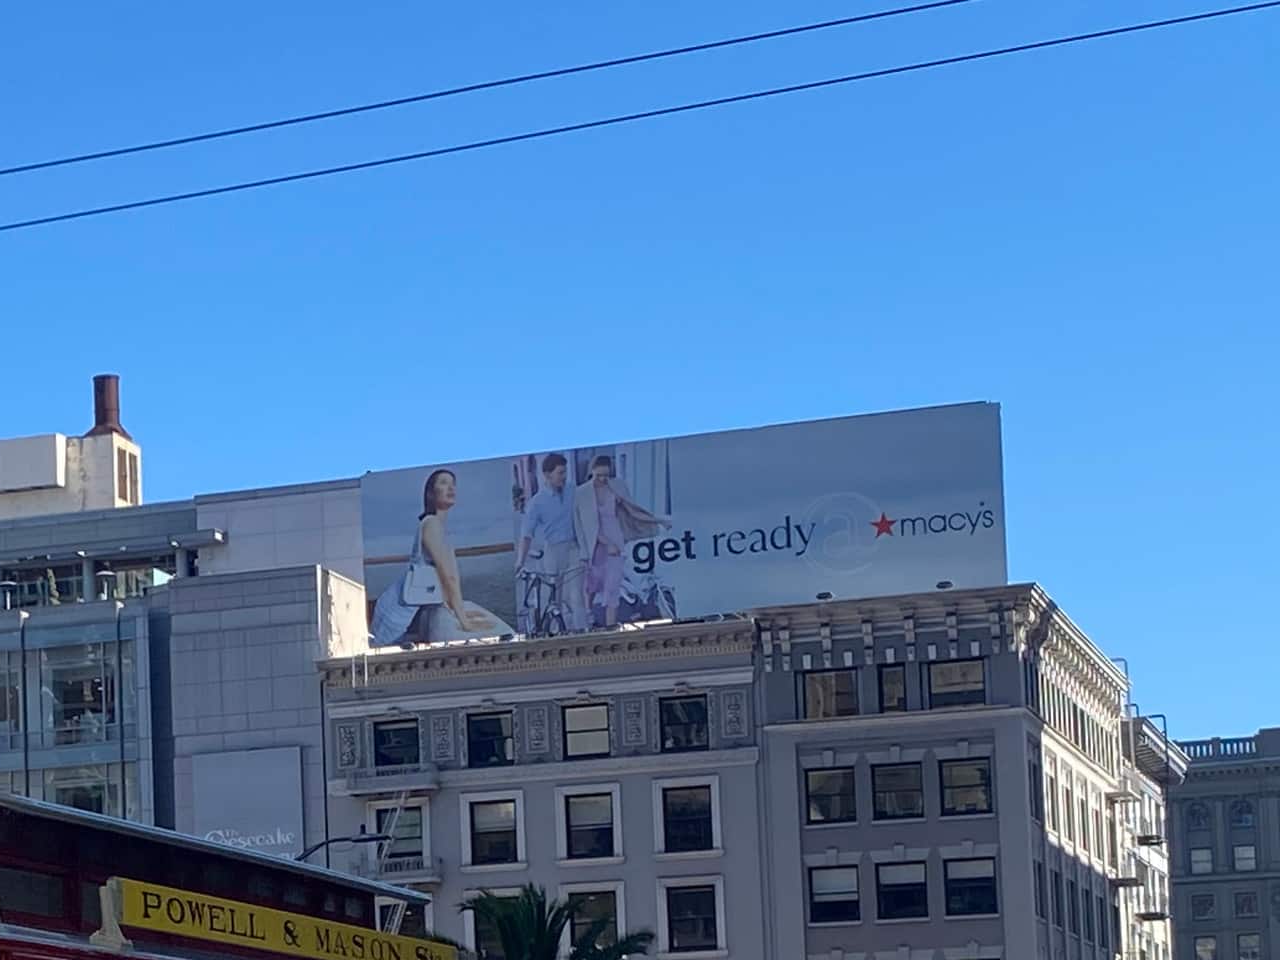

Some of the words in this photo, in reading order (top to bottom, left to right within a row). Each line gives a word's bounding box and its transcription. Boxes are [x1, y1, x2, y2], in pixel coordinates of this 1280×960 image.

[631, 530, 696, 574] get
[710, 515, 816, 557] ready
[899, 501, 995, 536] macy's
[142, 891, 266, 940] POWELL
[283, 919, 302, 948] &
